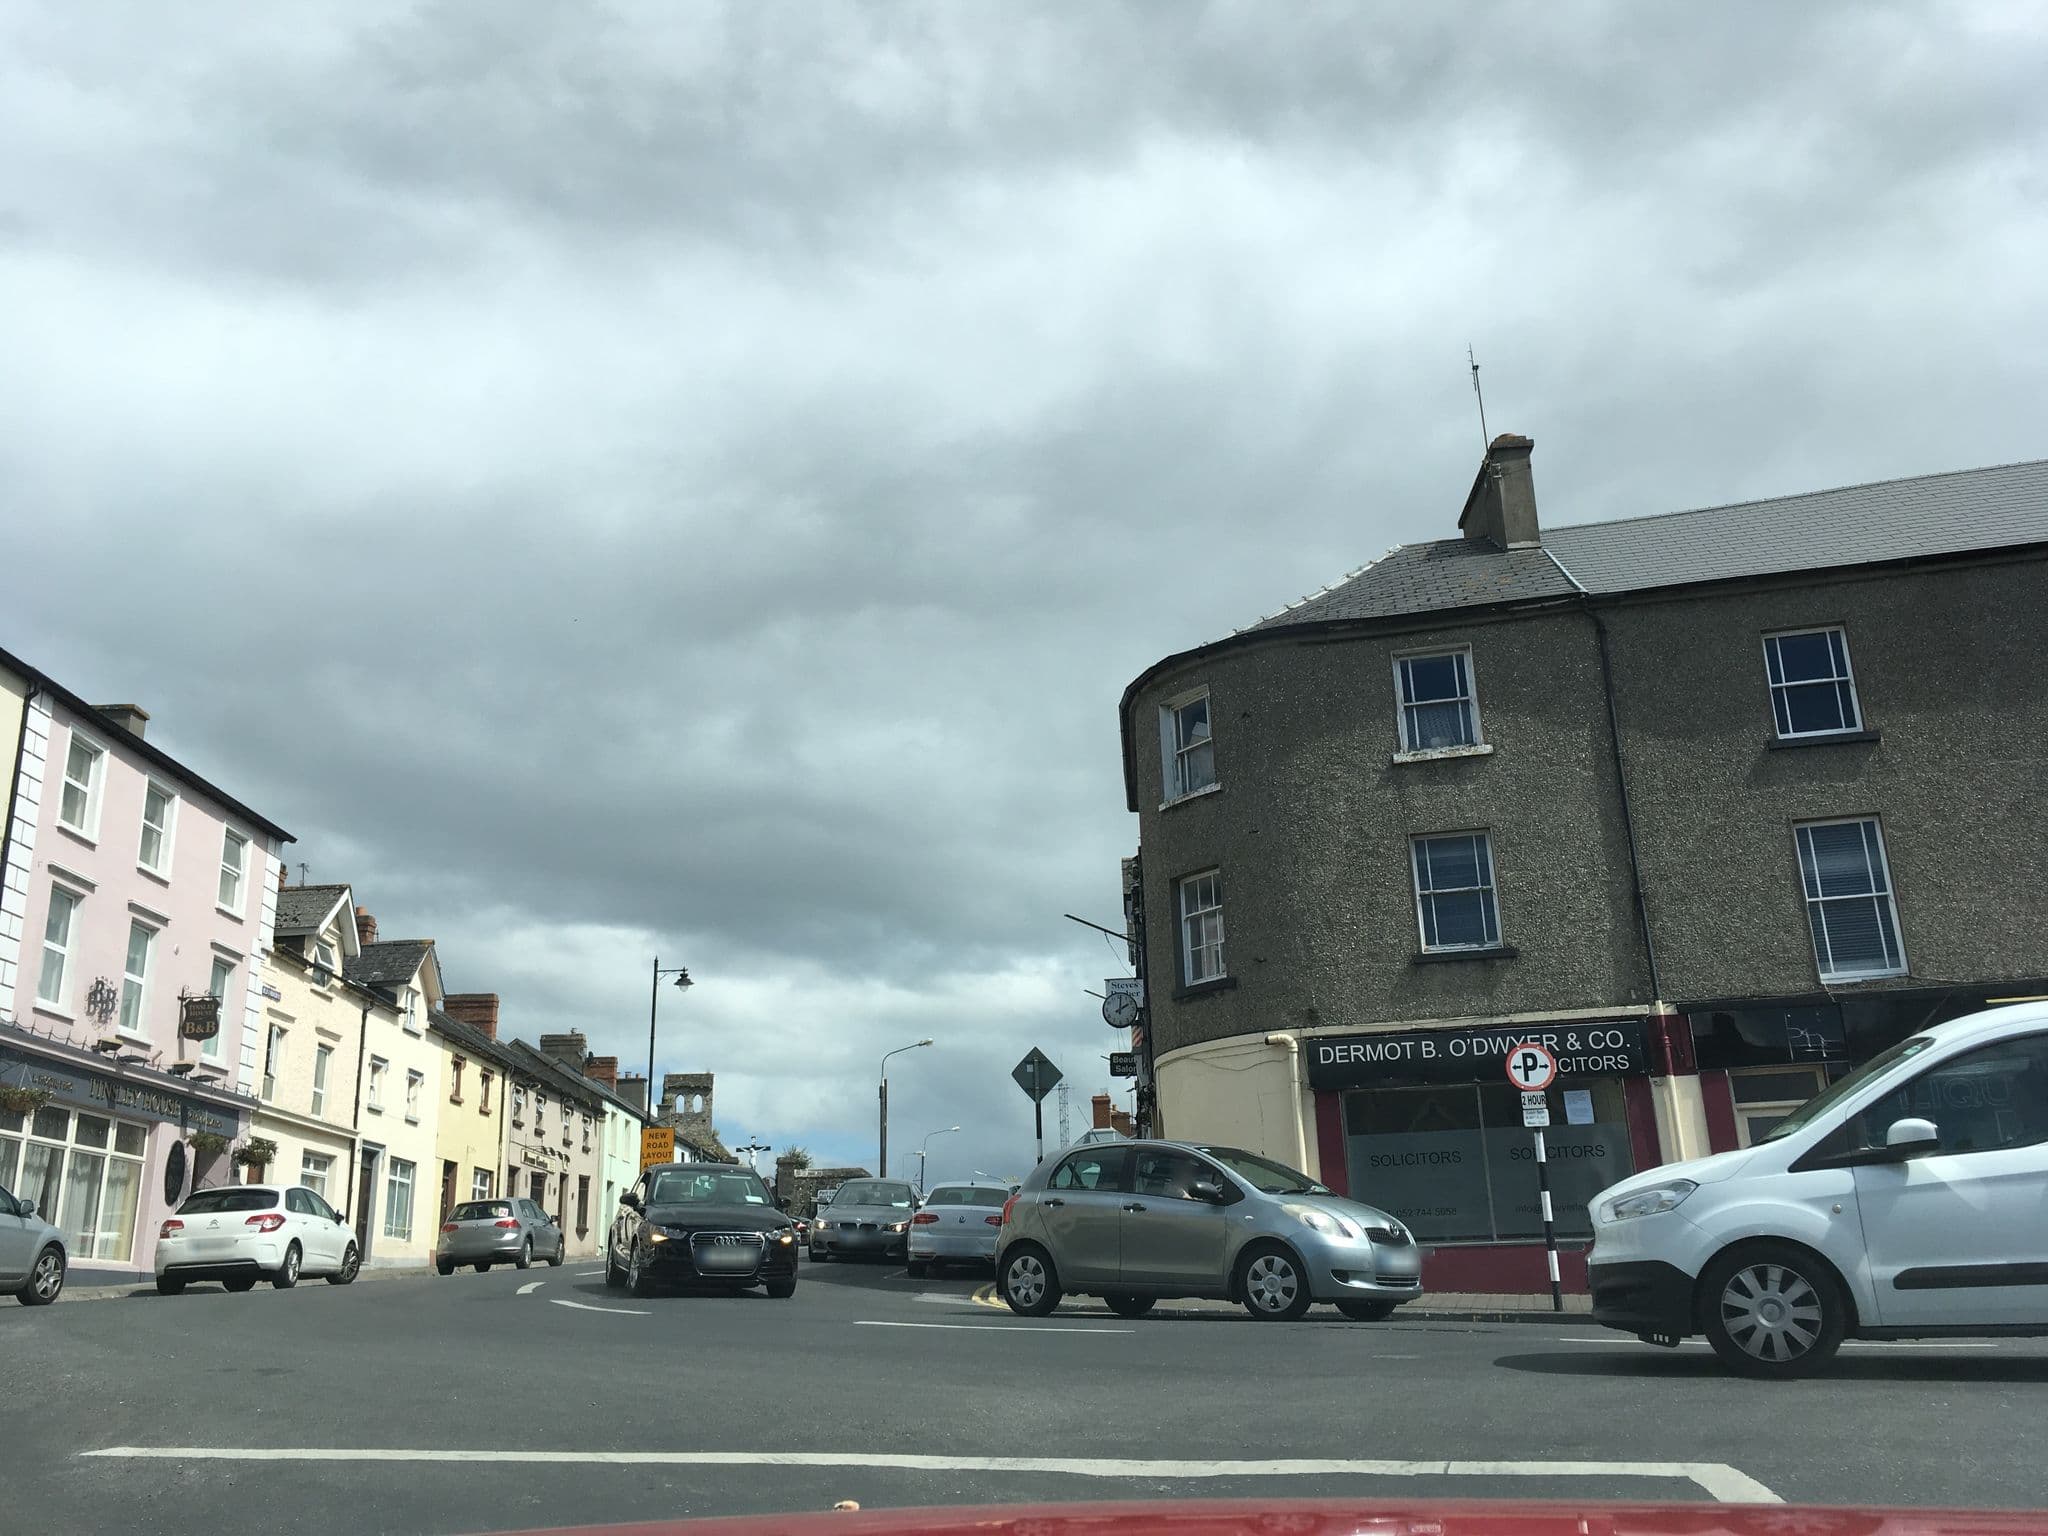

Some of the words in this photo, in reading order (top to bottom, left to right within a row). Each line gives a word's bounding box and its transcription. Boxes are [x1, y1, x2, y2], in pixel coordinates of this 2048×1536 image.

[185, 1021, 217, 1034] B&B
[1319, 1041, 1415, 1064] DERMOT
[1421, 1040, 1442, 1058] B.
[1567, 1032, 1582, 1051] &
[1589, 1030, 1631, 1050] CO.
[1113, 1056, 1137, 1064] Beaut
[1521, 1052, 1538, 1082] P
[1553, 1054, 1630, 1073] ICITORS
[90, 1078, 141, 1107] TINSLEY
[142, 1092, 181, 1118] HOUSE
[1522, 1095, 1527, 1106] 2
[1528, 1094, 1546, 1105] HOUR
[646, 1141, 669, 1149] ROAD
[1510, 1144, 1606, 1161] SOLCITORS
[641, 1150, 672, 1159] LAYOUT
[1371, 1150, 1462, 1168] SOLICITORS
